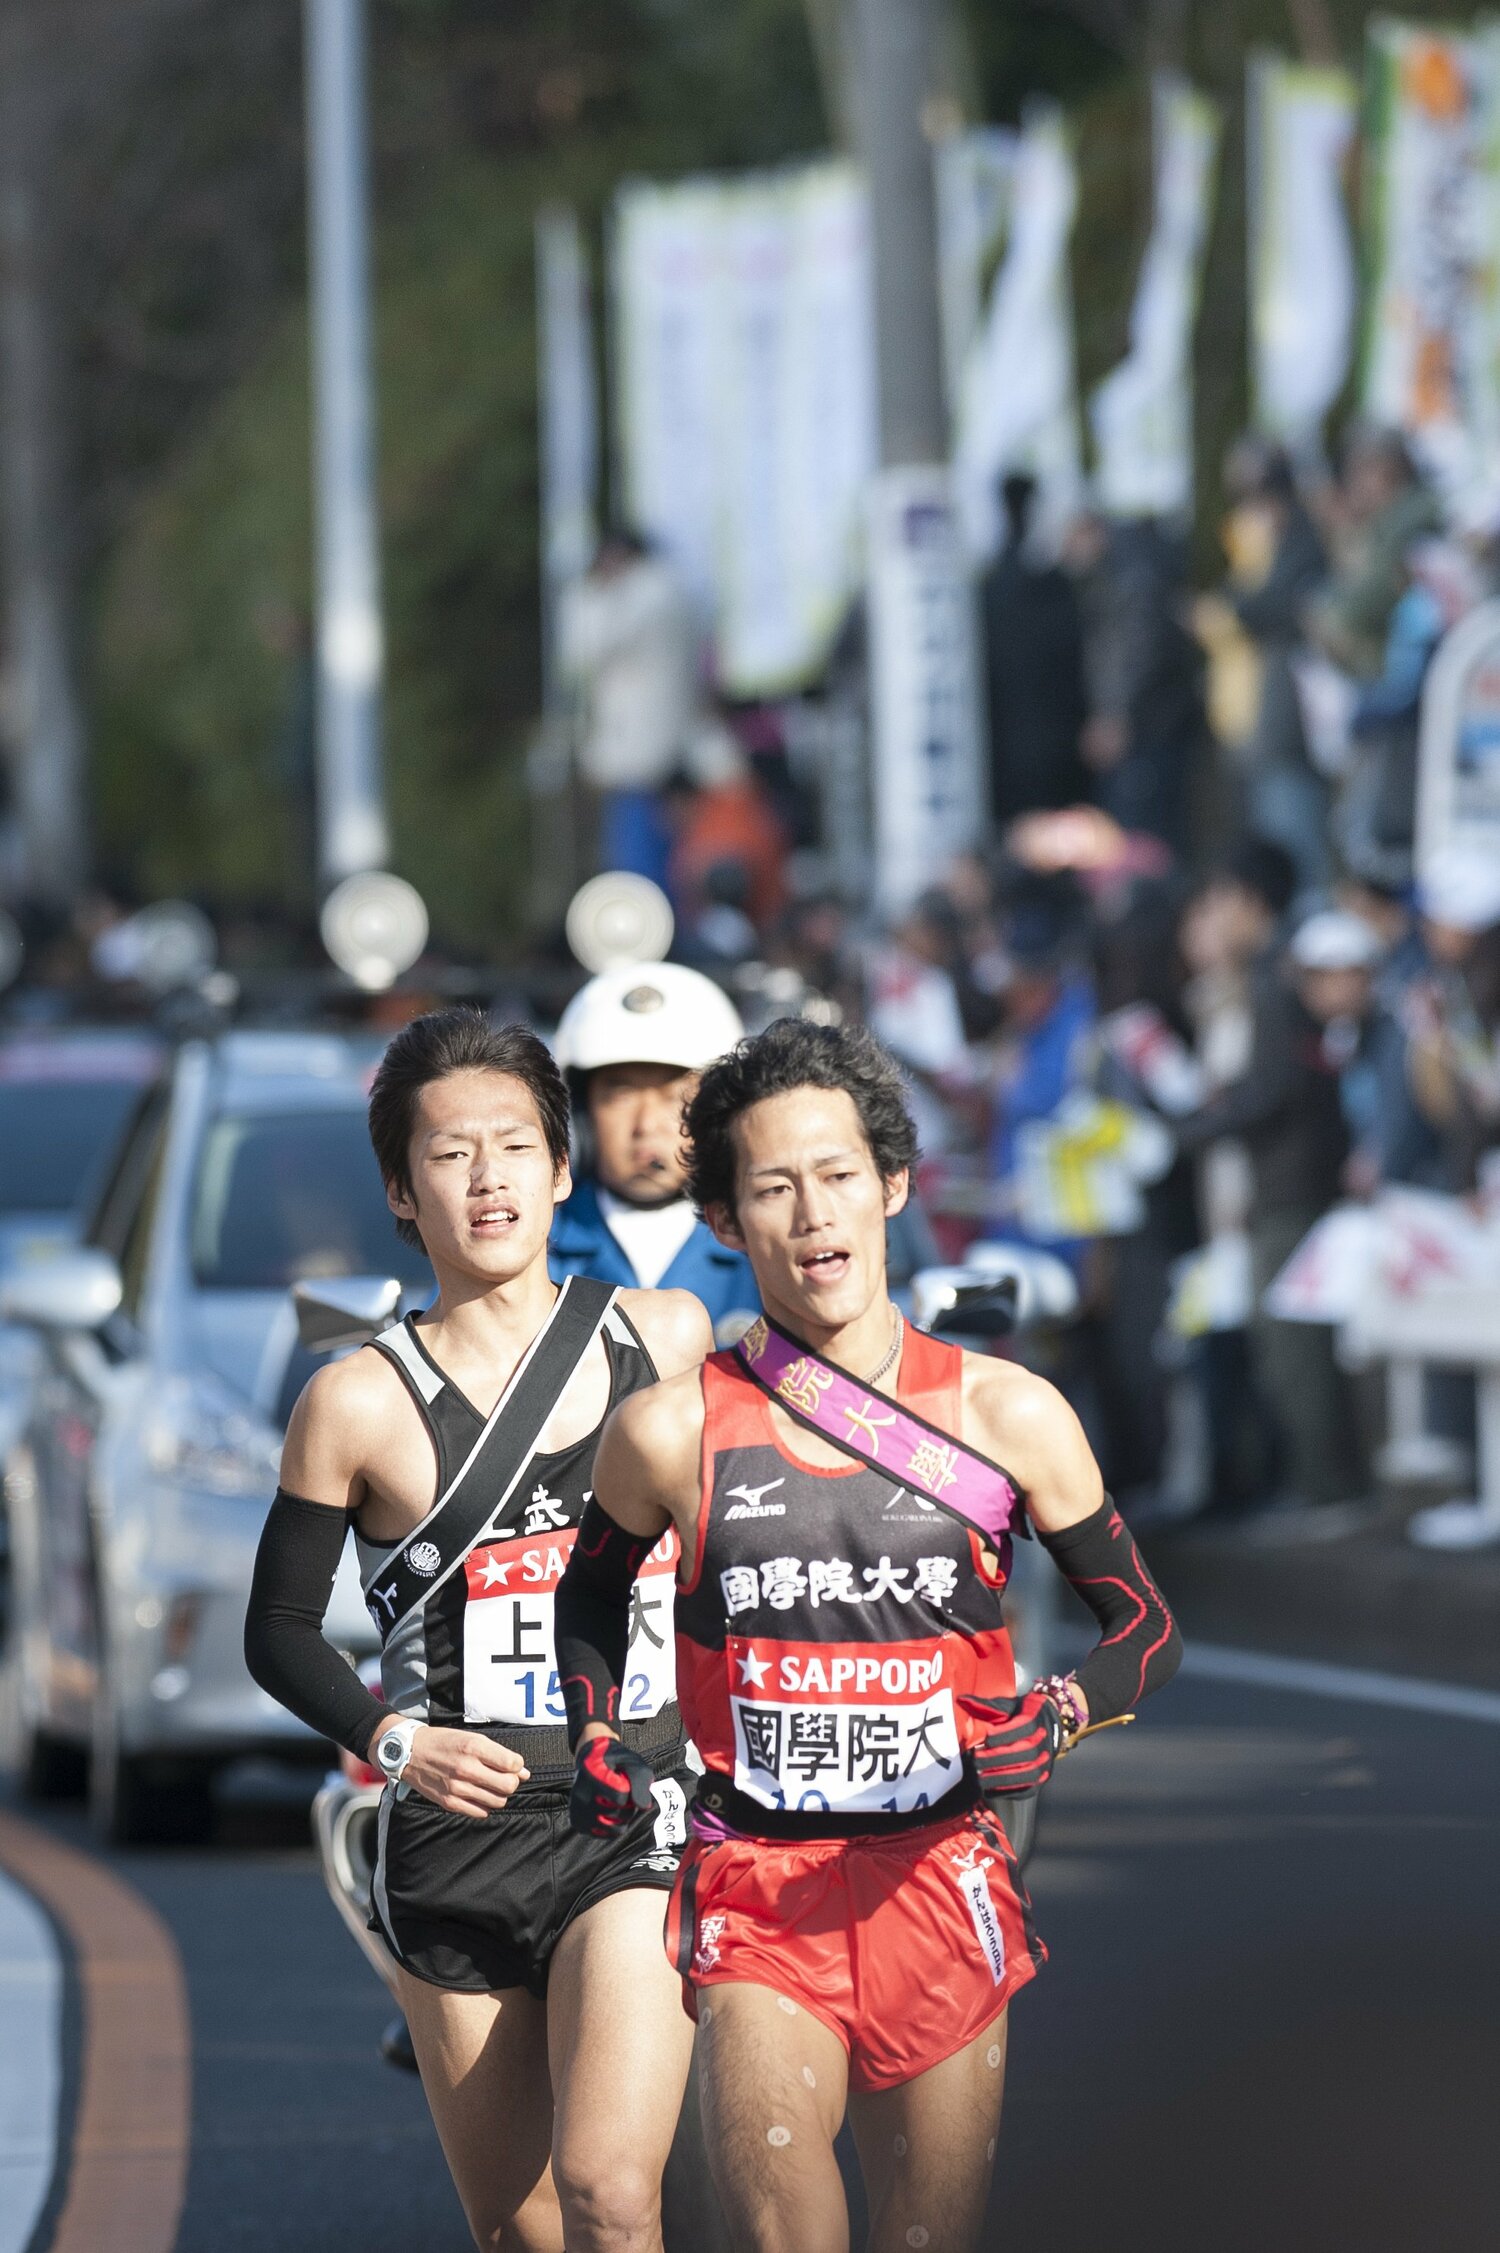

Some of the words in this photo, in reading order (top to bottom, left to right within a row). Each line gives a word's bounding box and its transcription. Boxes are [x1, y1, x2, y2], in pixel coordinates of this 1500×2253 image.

[720, 1556, 958, 1616] 國學院大學
[779, 1650, 943, 1694] SAPPORO
[738, 1704, 951, 1783] 國學院大
